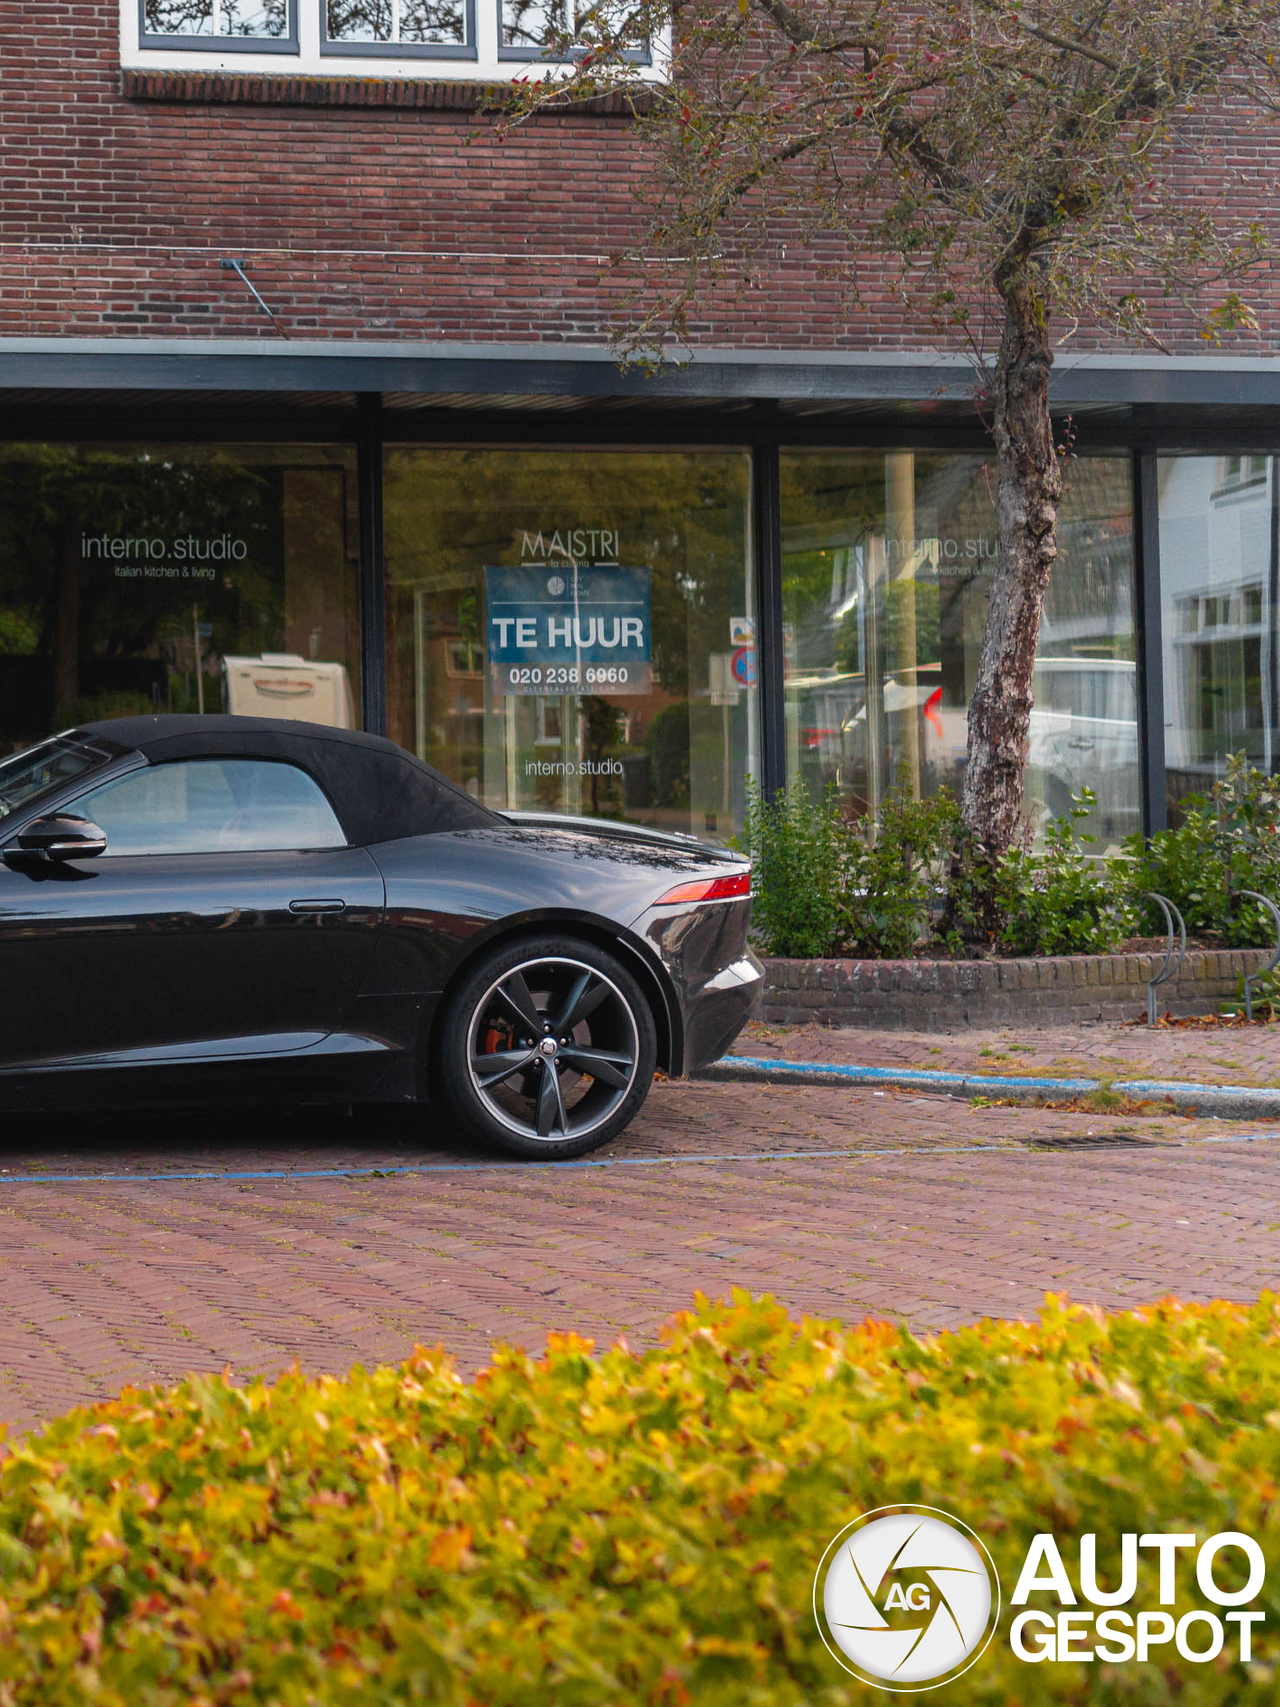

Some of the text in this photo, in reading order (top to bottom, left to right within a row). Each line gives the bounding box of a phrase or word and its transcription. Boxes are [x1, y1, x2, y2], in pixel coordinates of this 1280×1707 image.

[80, 531, 248, 560] interno.studio
[520, 529, 619, 558] MAISTRI
[114, 566, 216, 581] italian kitchen & living
[492, 617, 645, 649] TE HUUR
[509, 667, 628, 684] 020 238 6960
[524, 757, 624, 776] interno.studio
